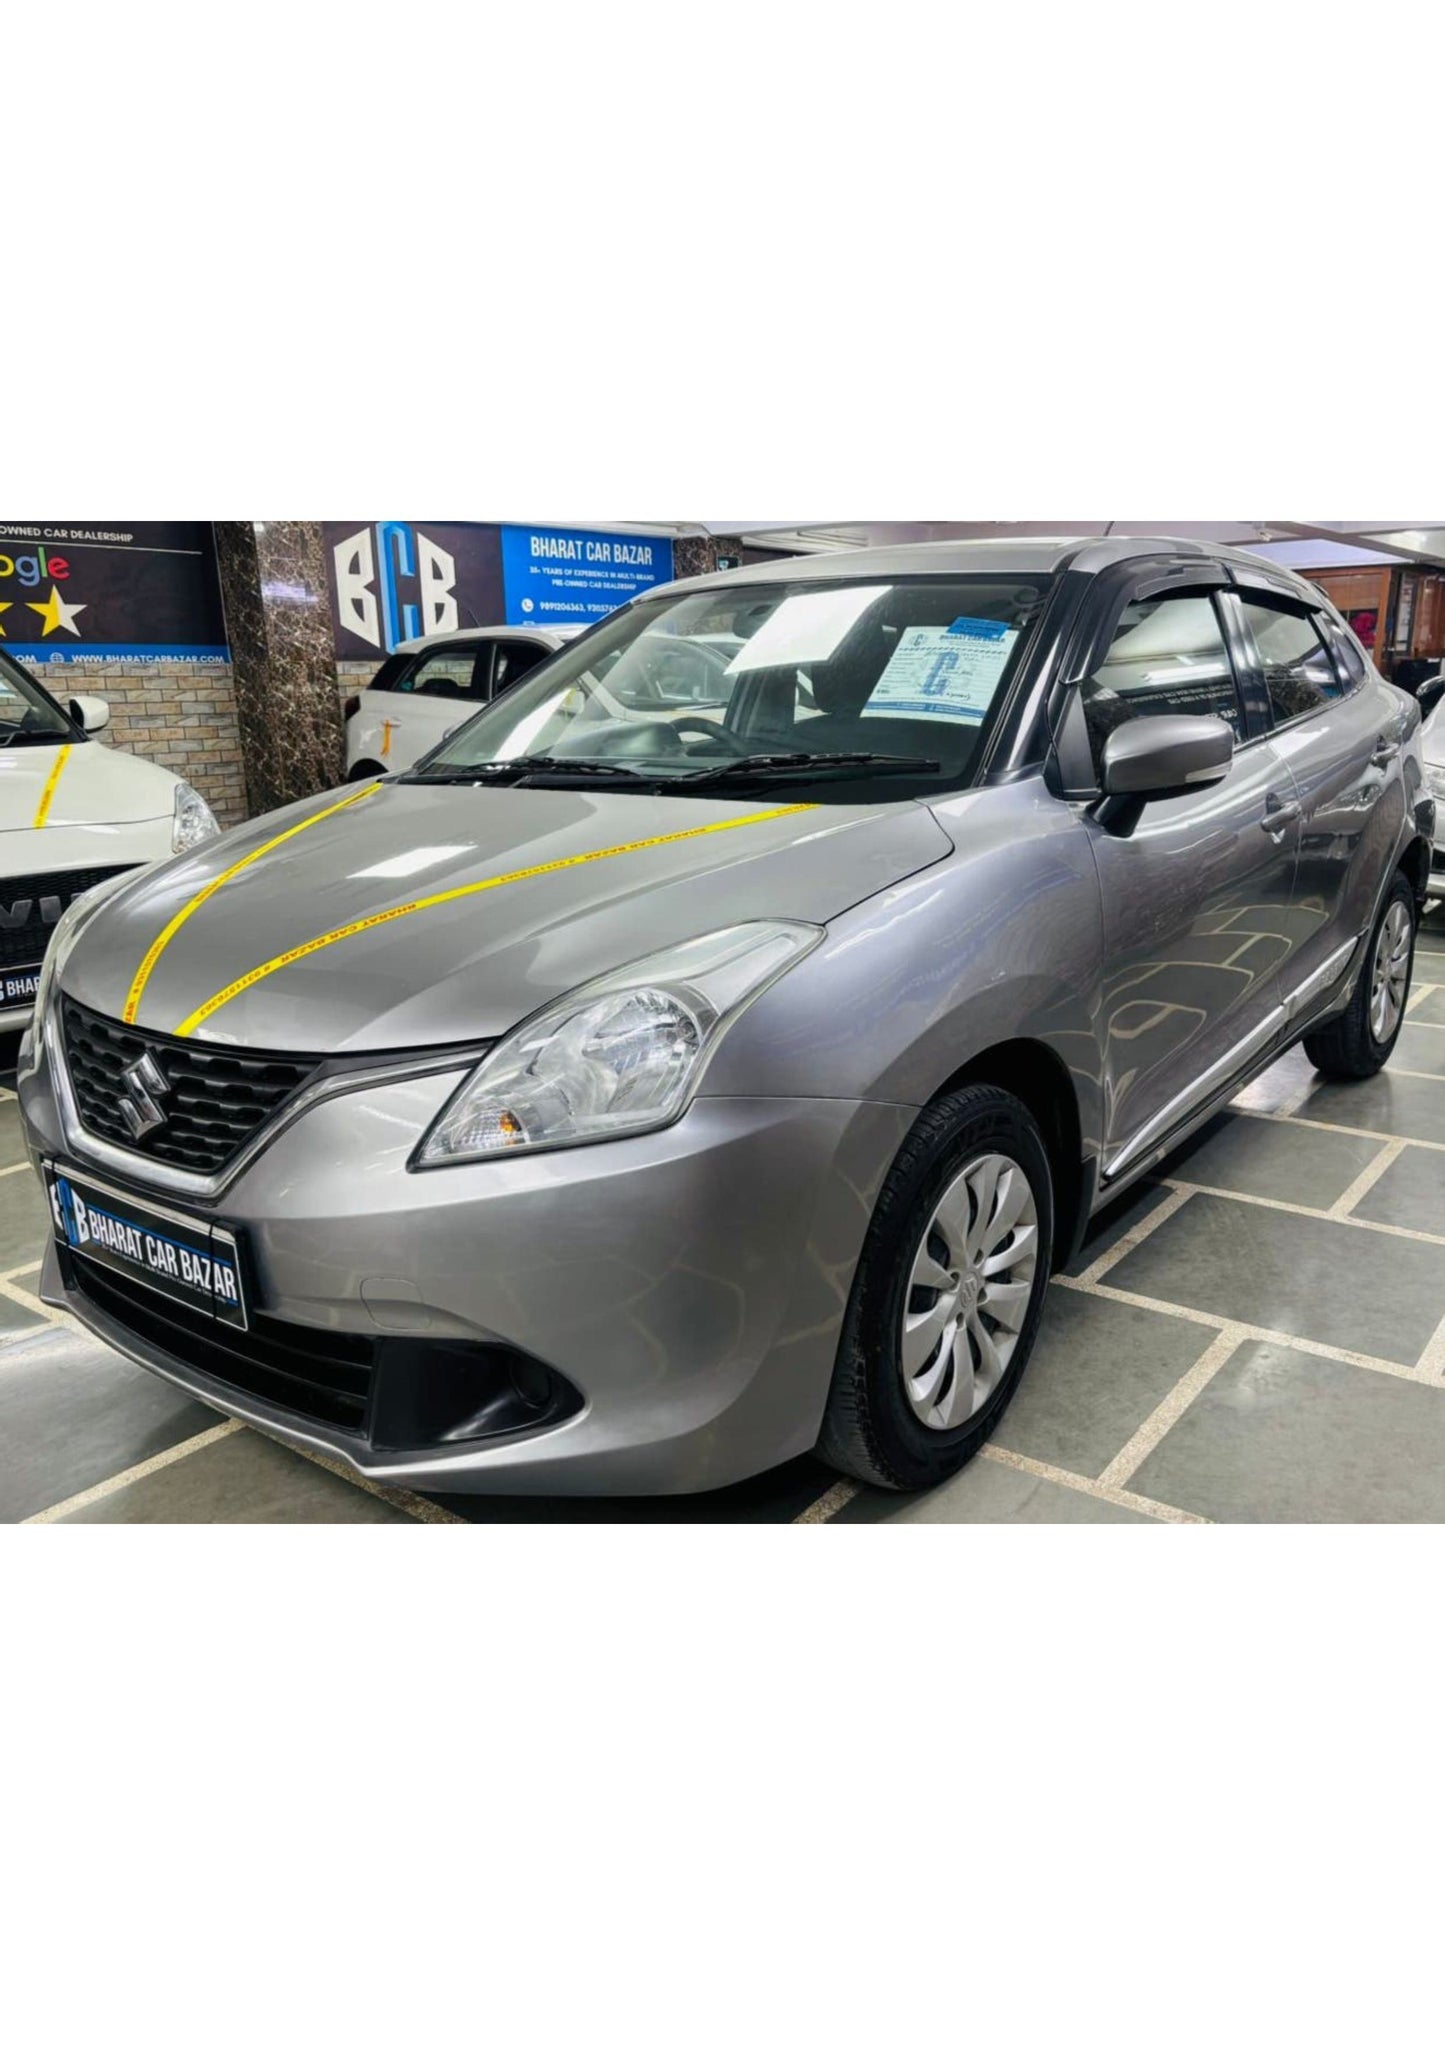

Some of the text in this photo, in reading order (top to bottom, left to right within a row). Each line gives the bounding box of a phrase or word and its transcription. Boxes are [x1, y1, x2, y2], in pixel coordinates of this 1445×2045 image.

[43, 528, 68, 538] CAR
[70, 530, 133, 542] DEALERSHIP
[530, 536, 653, 566] BHARAT CAR BAZAR
[71, 653, 225, 665] WWW.BHARATCARBAZAR.COM
[89, 1210, 143, 1261] BHARAT
[146, 1236, 179, 1276] CAR
[180, 1248, 238, 1302] BAZAR
